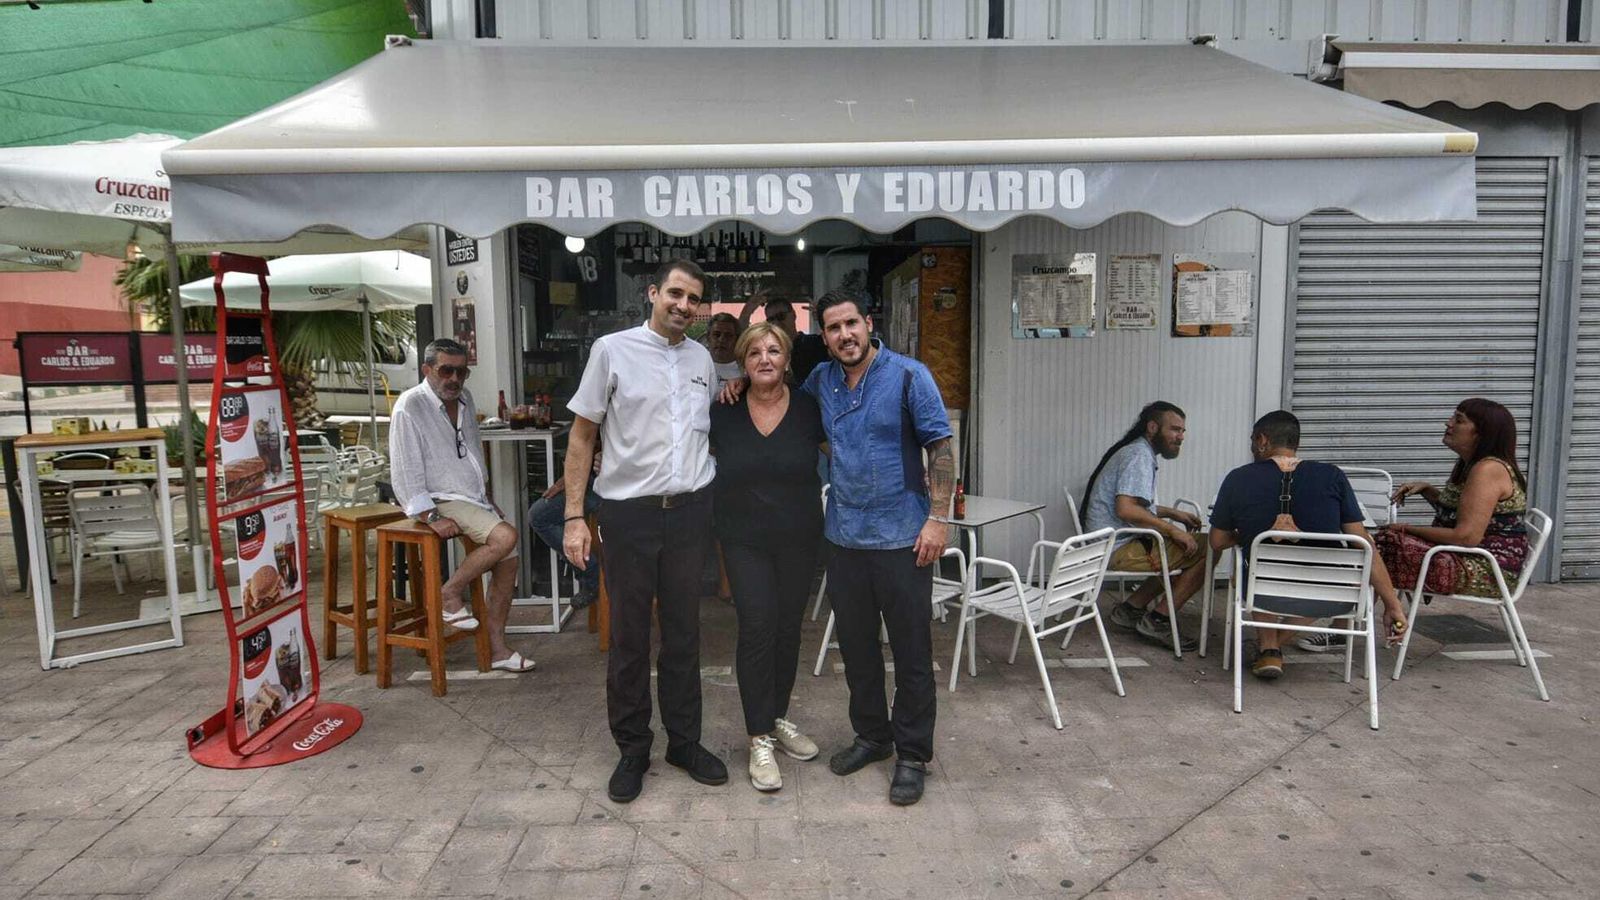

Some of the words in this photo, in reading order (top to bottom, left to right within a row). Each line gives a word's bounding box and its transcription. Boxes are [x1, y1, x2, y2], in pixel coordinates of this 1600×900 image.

[95, 176, 170, 202] Cruzcam
[525, 177, 614, 218] BAR
[643, 173, 813, 217] CARLOS
[835, 173, 862, 214] Y
[882, 168, 1086, 213] EDUARDO
[113, 202, 167, 219] ESPECIA
[448, 246, 475, 264] USTEDES
[577, 255, 598, 282] 18
[1032, 265, 1077, 275] Cruzcampo
[66, 346, 88, 356] BAR
[41, 356, 71, 366] CARLOS
[72, 357, 79, 367] &
[81, 356, 115, 366] EDUARDO
[292, 717, 344, 751] Coca-Cola
